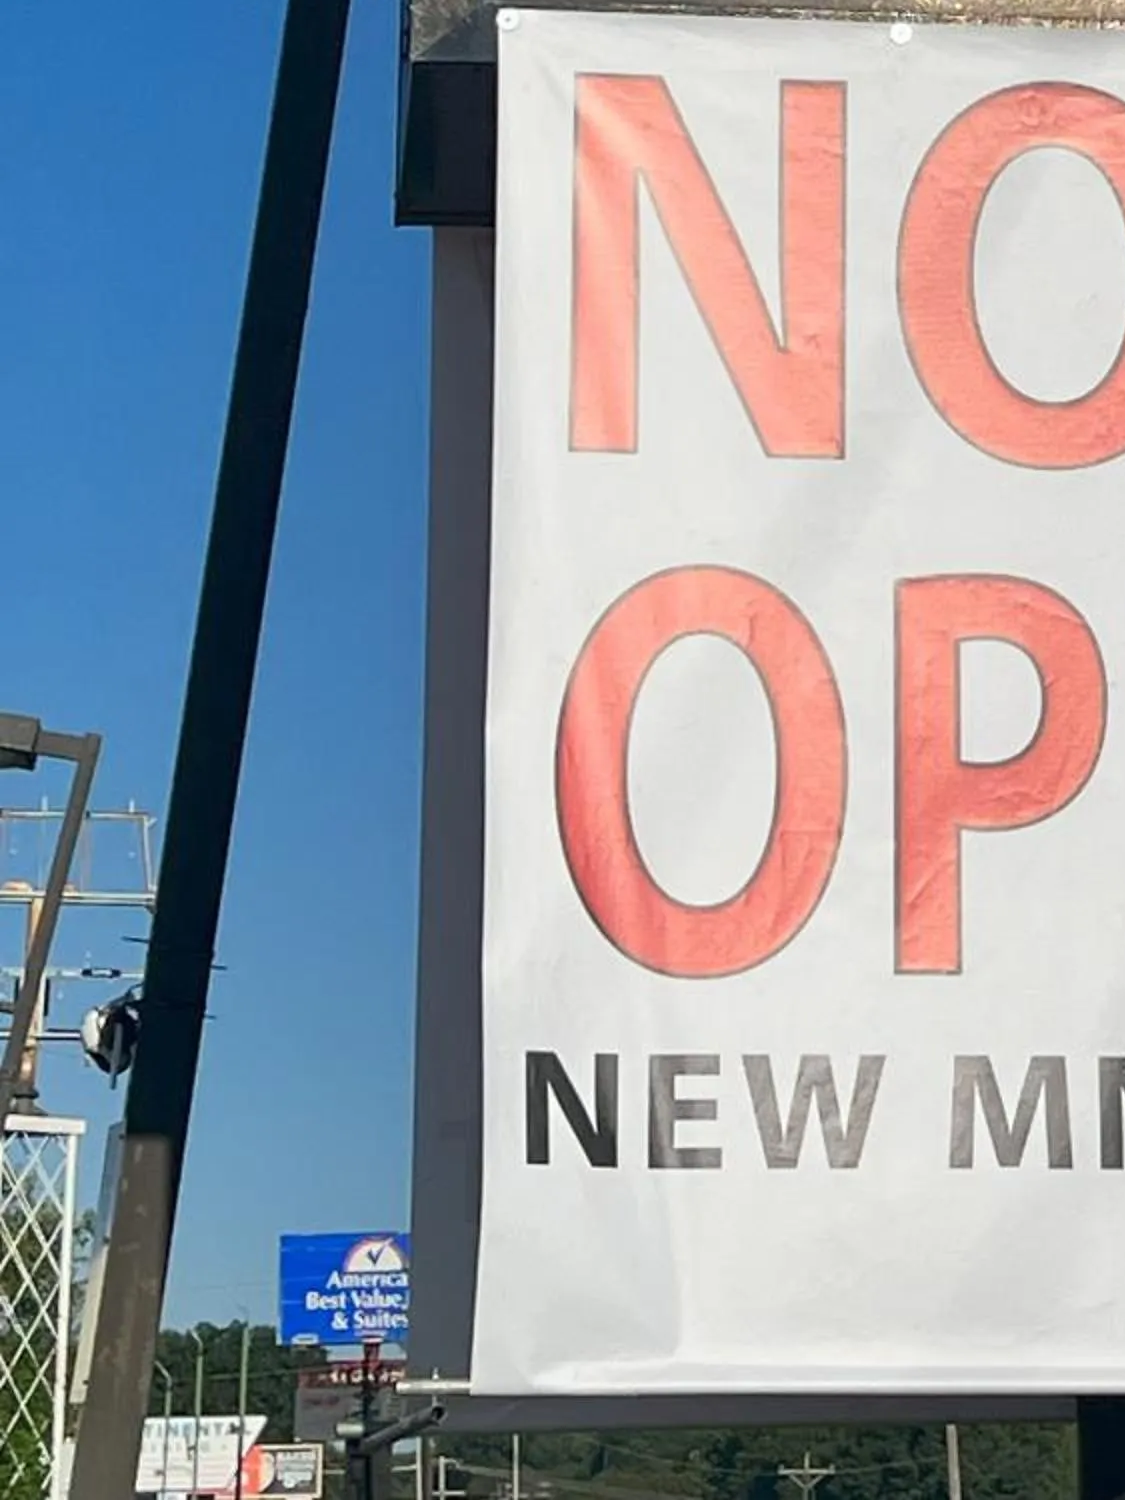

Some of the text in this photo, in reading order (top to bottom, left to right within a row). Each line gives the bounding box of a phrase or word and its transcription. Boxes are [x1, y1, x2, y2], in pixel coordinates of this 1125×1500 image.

[525, 1050, 886, 1172] NEW
[305, 1290, 346, 1310] Best
[350, 1288, 404, 1309] Value
[331, 1311, 348, 1330] &
